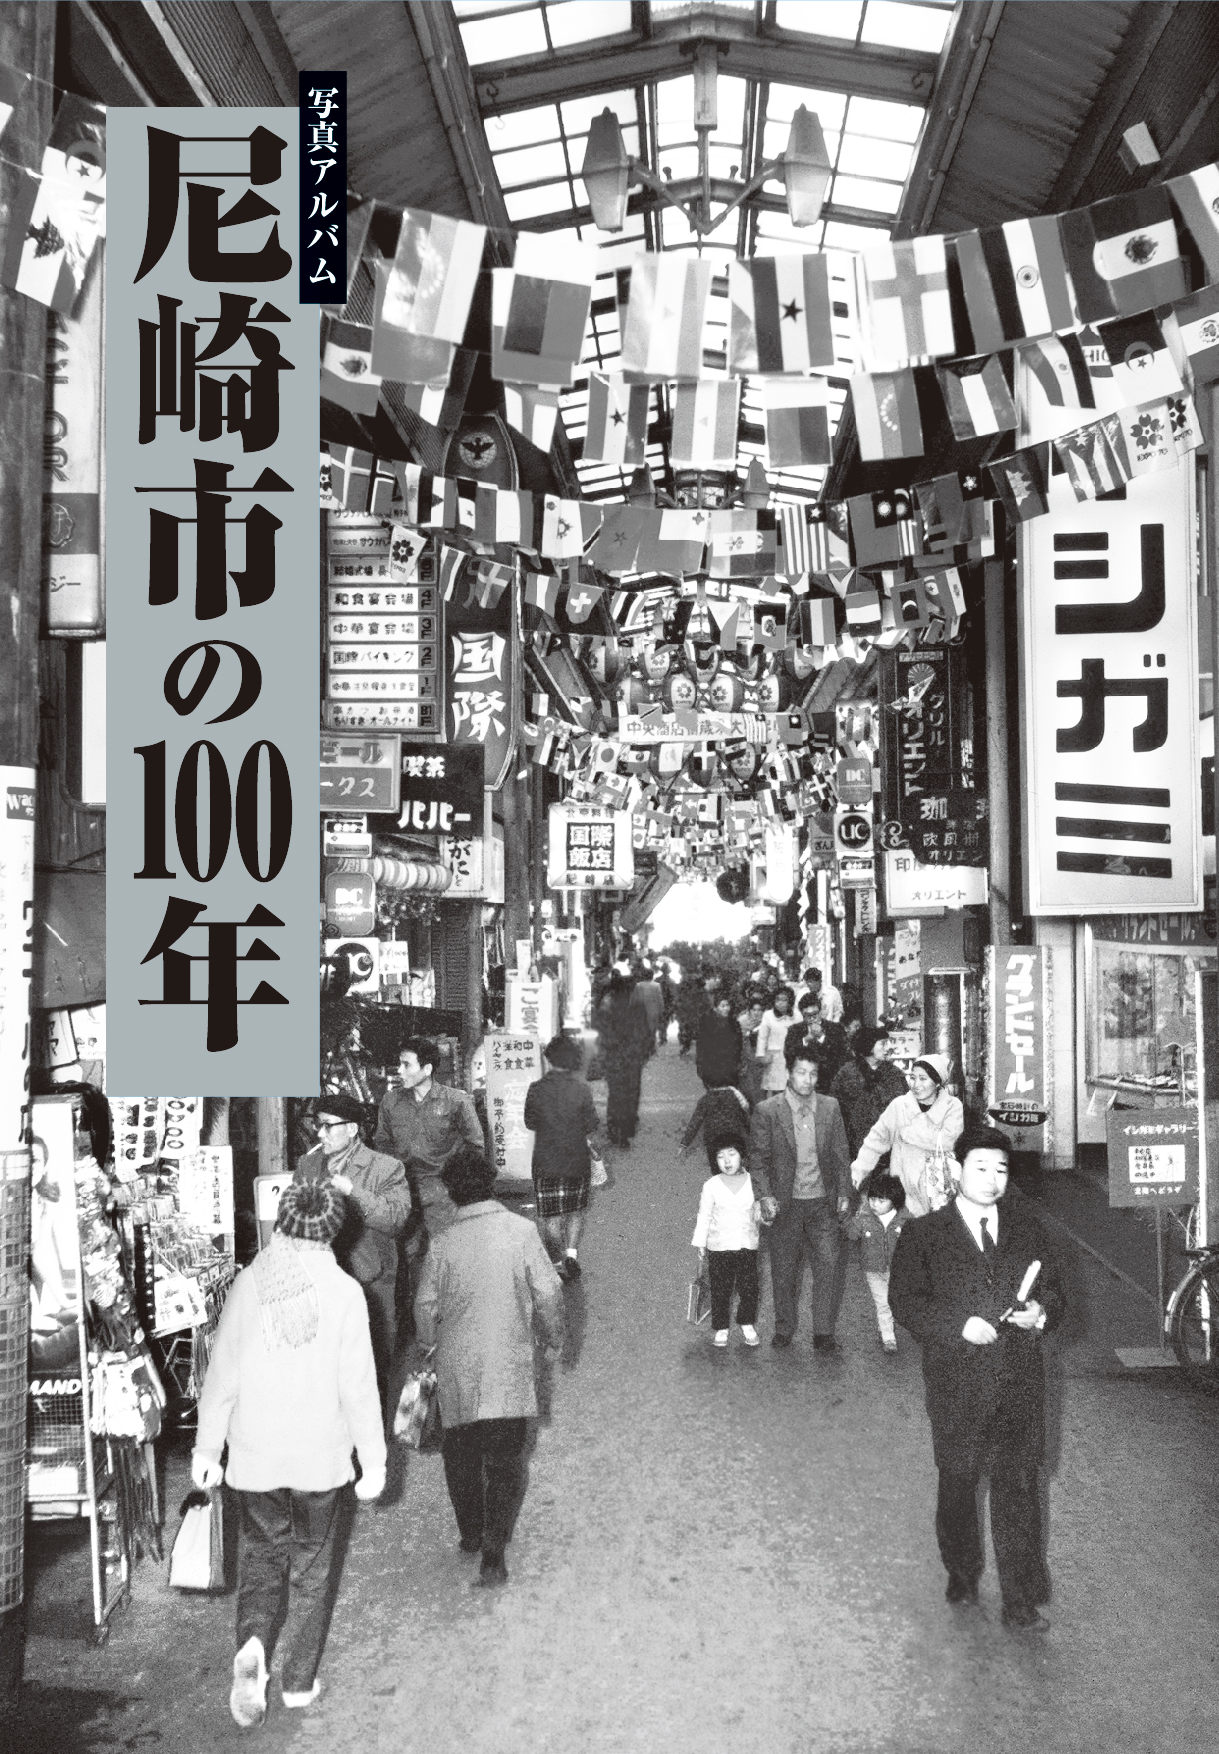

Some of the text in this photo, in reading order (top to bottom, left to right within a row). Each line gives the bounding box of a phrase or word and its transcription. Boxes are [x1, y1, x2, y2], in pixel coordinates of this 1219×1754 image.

[451, 631, 506, 742] 国際
[1054, 487, 1172, 878] シガミ
[841, 822, 869, 840] UC
[912, 889, 967, 901] オリエント
